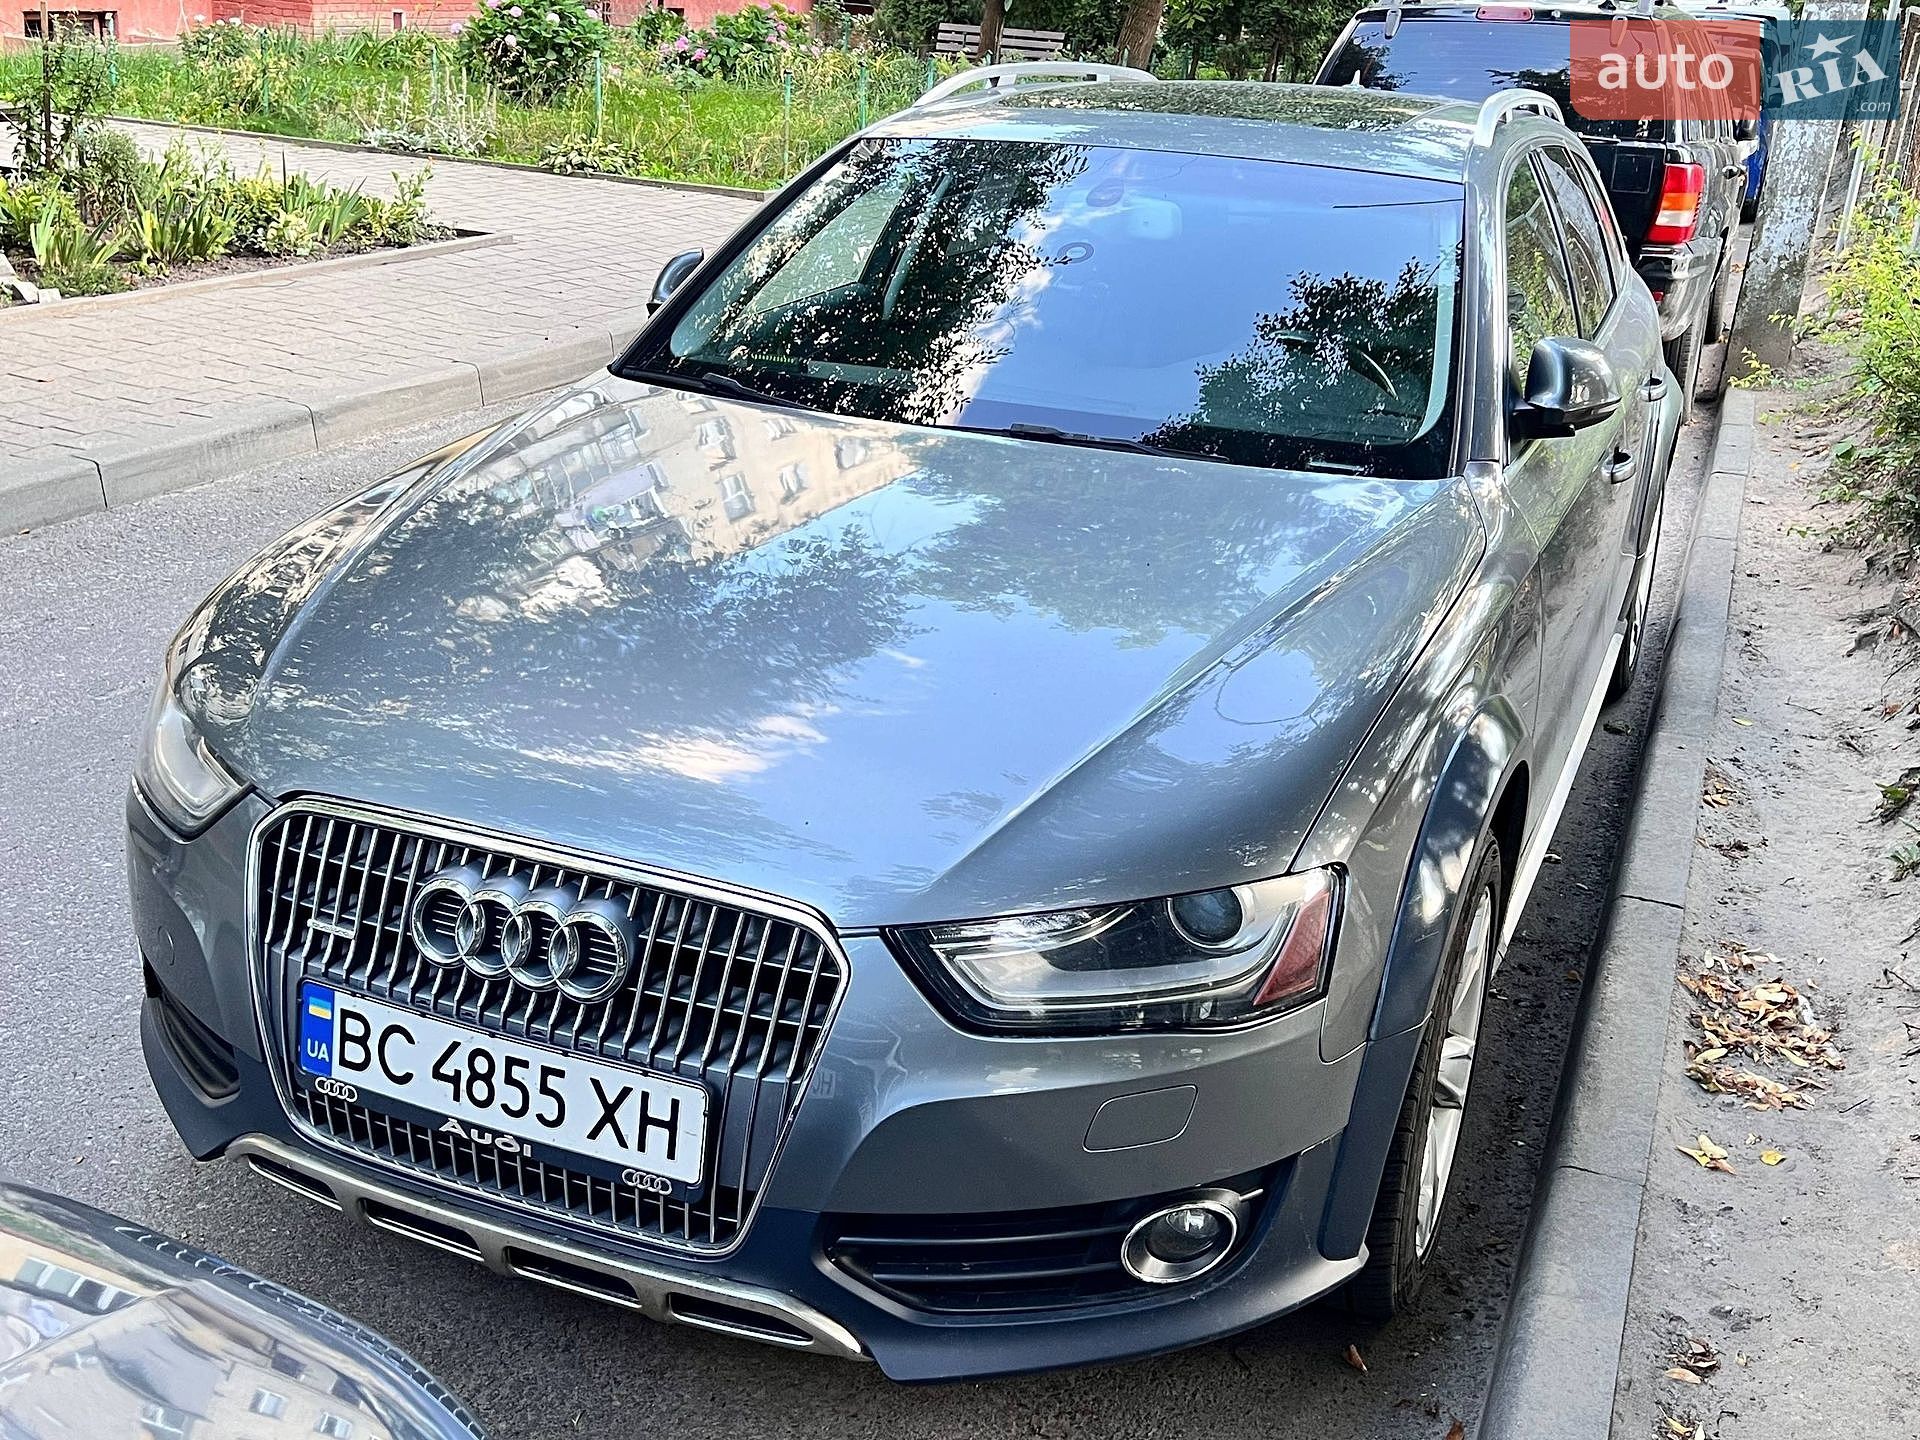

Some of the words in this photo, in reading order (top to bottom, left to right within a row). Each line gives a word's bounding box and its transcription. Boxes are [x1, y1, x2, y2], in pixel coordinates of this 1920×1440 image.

[307, 1038, 329, 1062] UA
[339, 1008, 415, 1085] BC
[432, 1041, 566, 1129] 4855
[586, 1077, 680, 1161] XH
[439, 1117, 532, 1157] Audi
